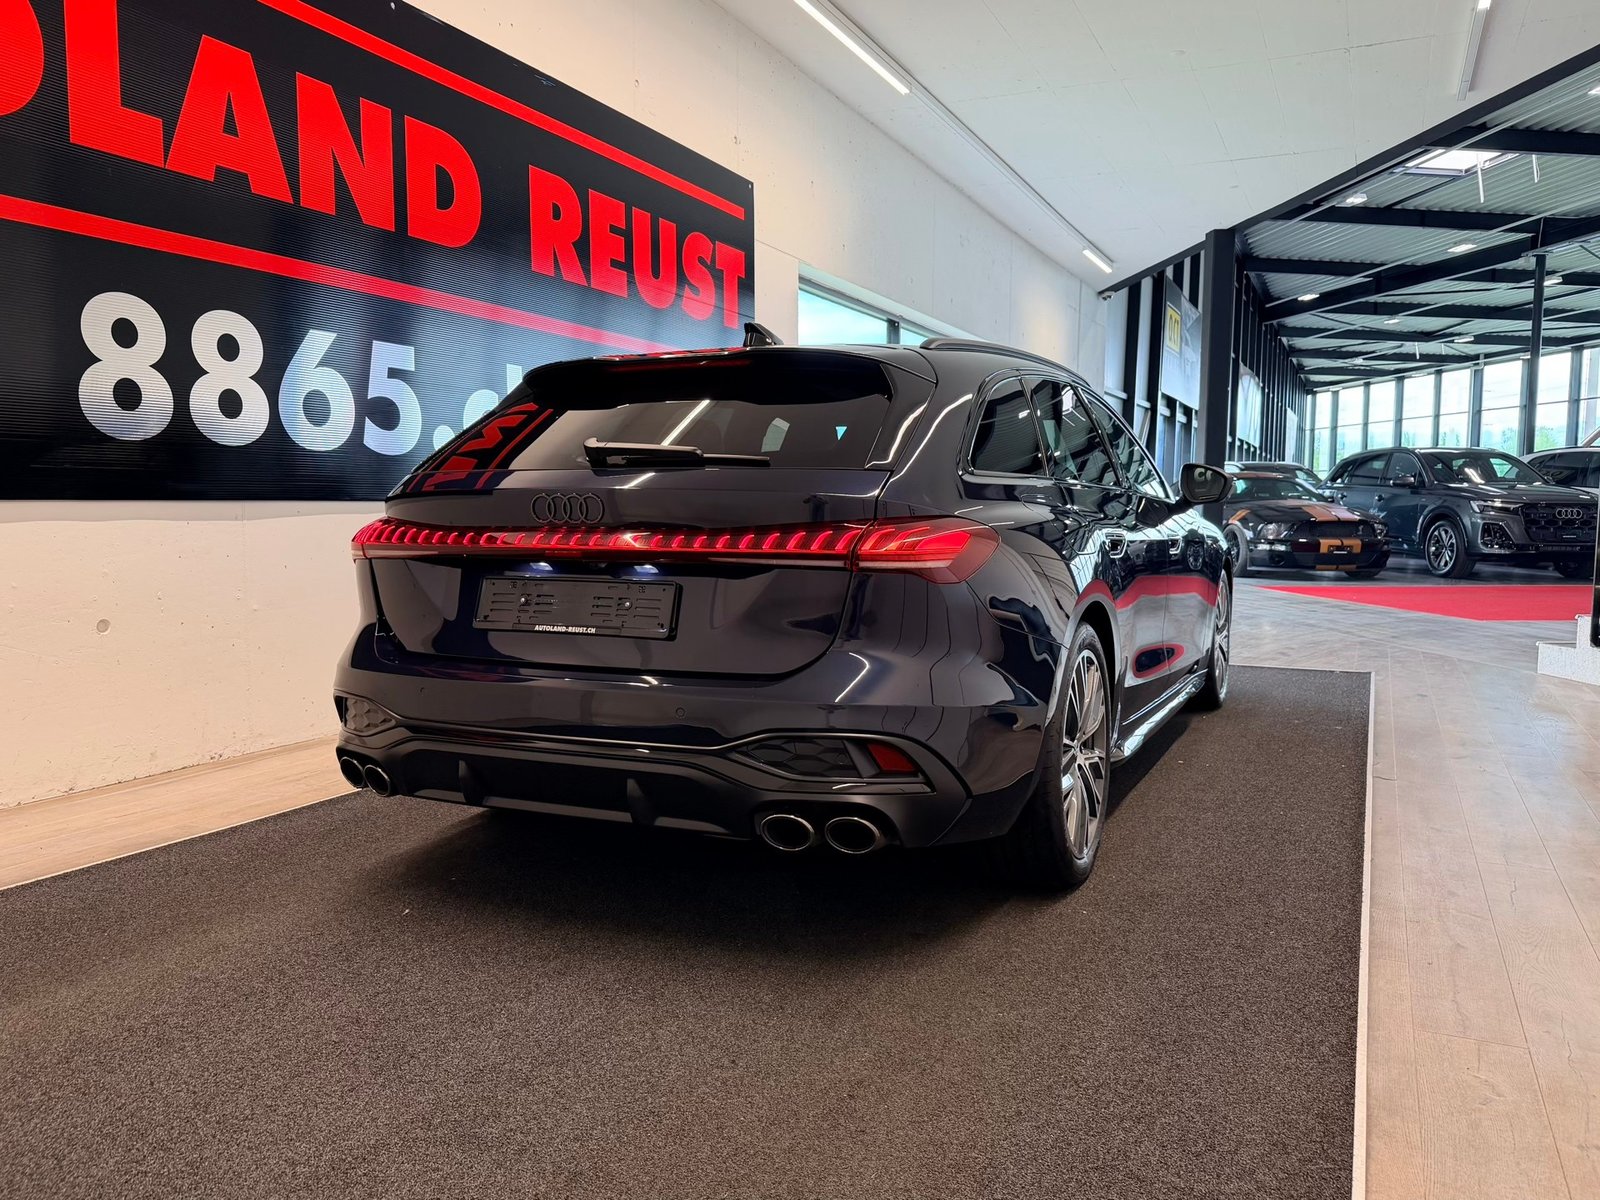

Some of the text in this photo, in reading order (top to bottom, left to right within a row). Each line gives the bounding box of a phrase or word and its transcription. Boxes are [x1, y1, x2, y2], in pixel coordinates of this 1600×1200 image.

[529, 164, 746, 329] REUST
[78, 291, 523, 456] 8865.
[534, 624, 596, 634] AUTOLAND-REUST.CH
